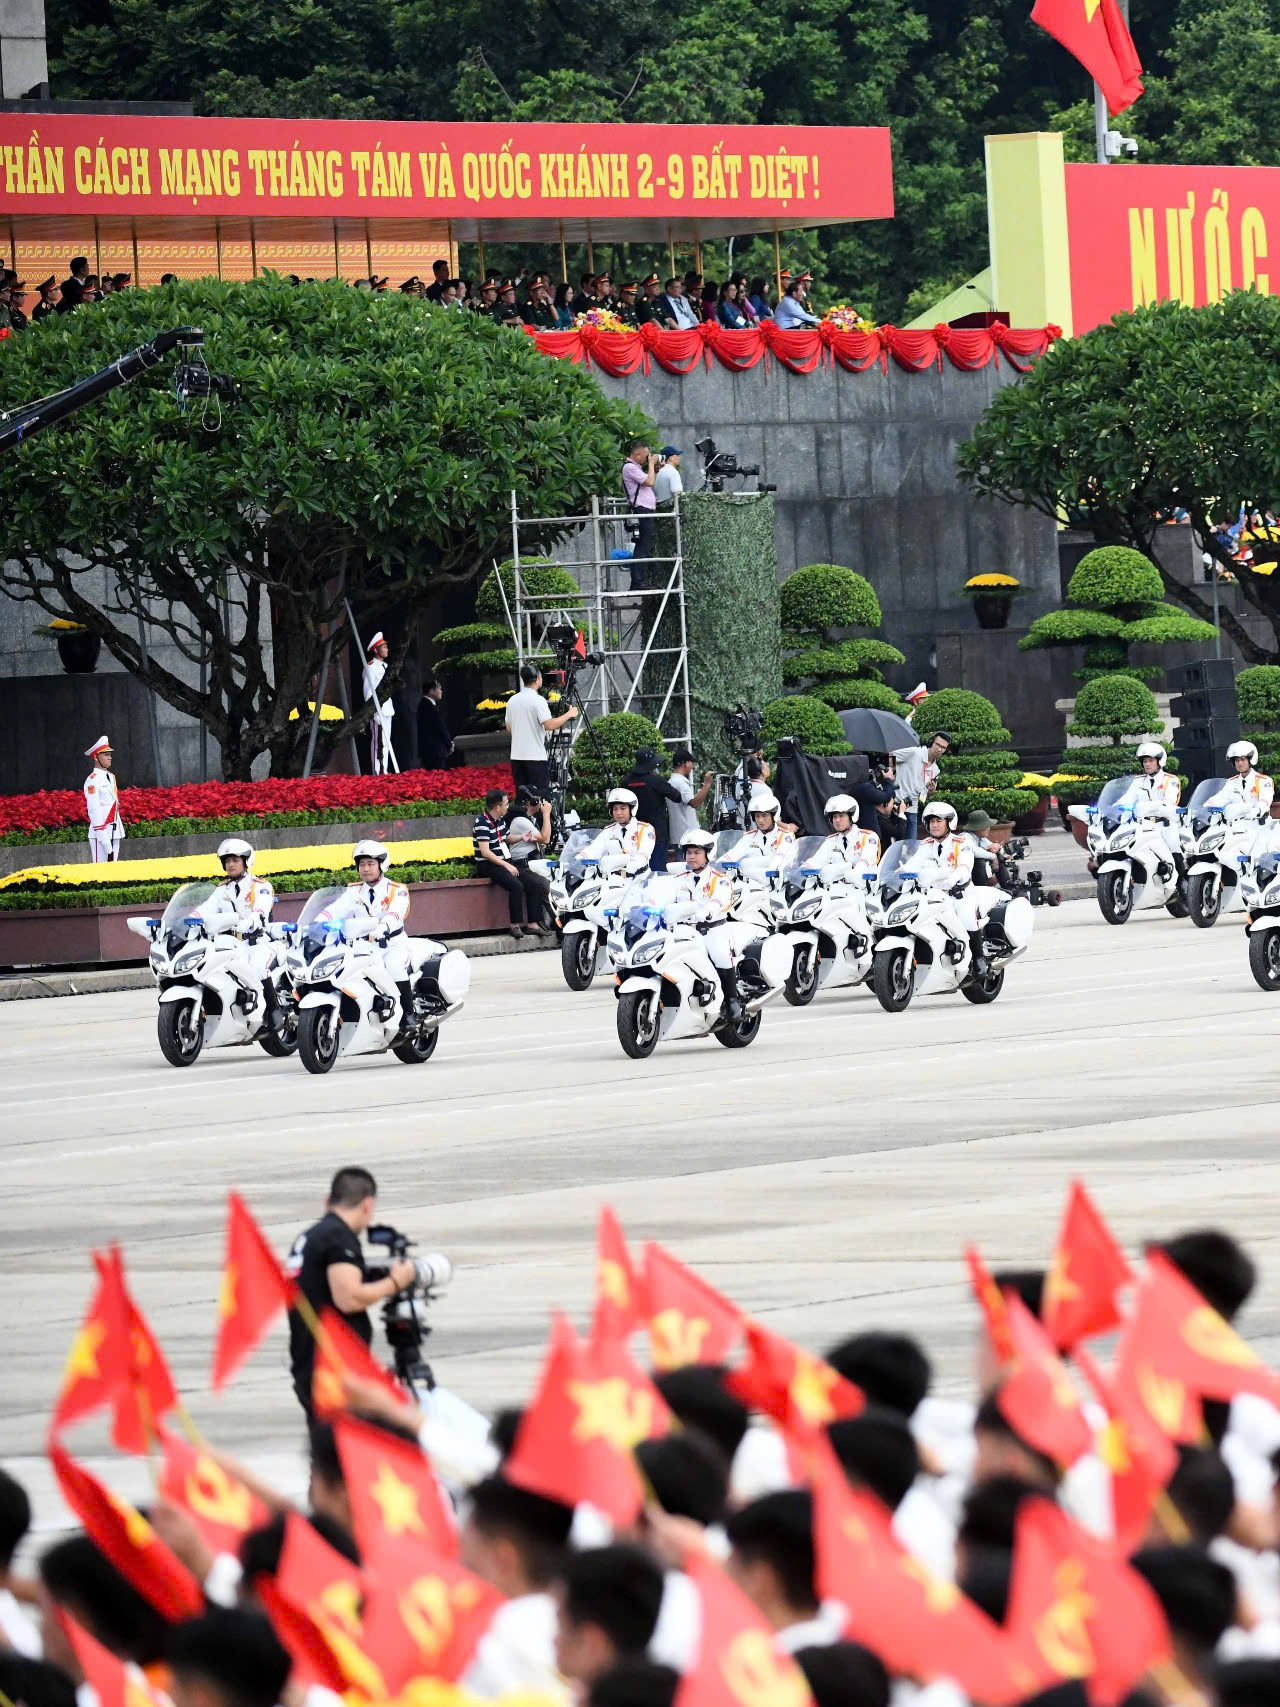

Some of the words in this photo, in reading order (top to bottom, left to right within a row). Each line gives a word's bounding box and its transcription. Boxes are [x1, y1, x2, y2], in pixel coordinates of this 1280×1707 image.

[0, 129, 64, 194] HẦN
[74, 137, 151, 195] CÁCH
[159, 148, 241, 206] MẠNG
[247, 140, 344, 197] THÁNG
[351, 141, 413, 197] TÁM
[419, 142, 456, 198] VÀ
[462, 138, 532, 203] QUỐC
[539, 144, 630, 198] KHÁNH
[636, 153, 685, 200] 2-9
[691, 141, 742, 199] BẤT
[749, 145, 820, 208] DIỆT!
[1128, 187, 1270, 312] NƯỚC
